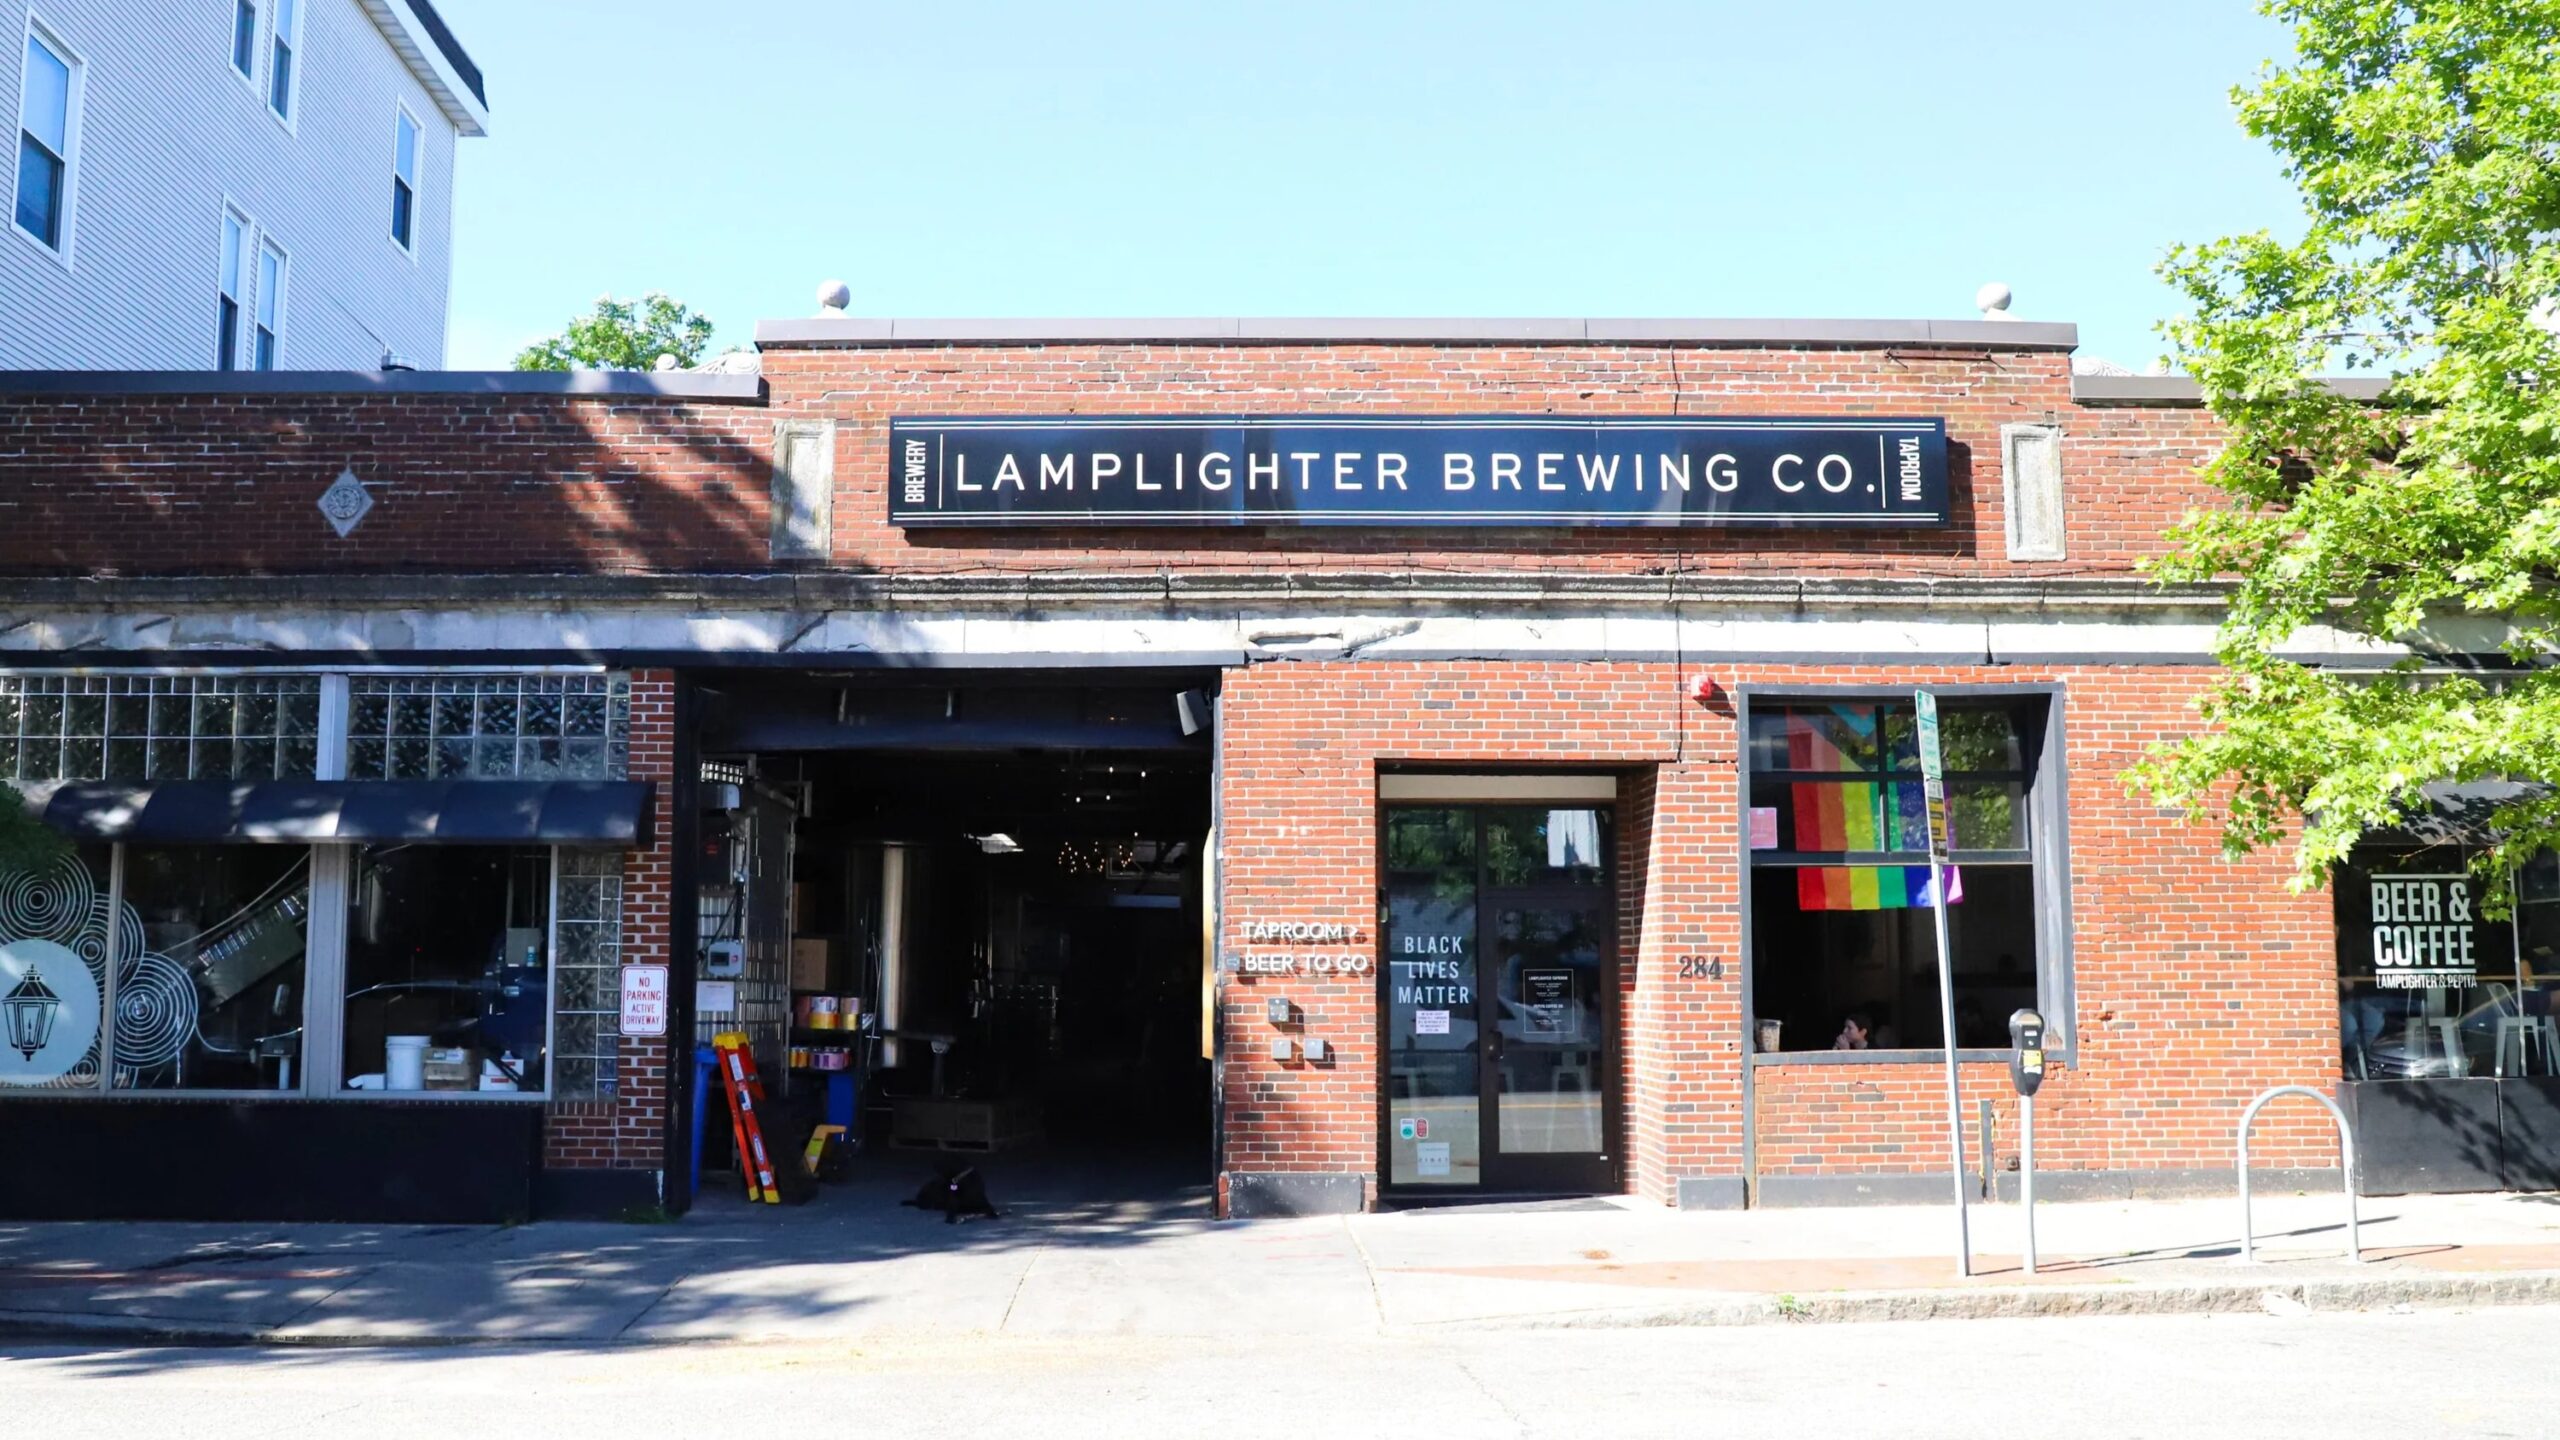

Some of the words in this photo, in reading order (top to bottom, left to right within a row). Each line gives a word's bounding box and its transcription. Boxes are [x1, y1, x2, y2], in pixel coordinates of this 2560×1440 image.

[905, 439, 926, 503] BREWERY
[956, 453, 1408, 491] LAMPLIGHTER
[1444, 453, 1739, 493] BREWING
[1771, 454, 1876, 493] CO.
[1899, 436, 1921, 501] TAPROOM
[2371, 882, 2441, 922] BEER
[2448, 882, 2473, 922] &
[1241, 921, 1342, 939] TAPROOM
[1404, 936, 1463, 954] BLACK
[2373, 925, 2476, 967] COFFEE
[1245, 953, 1294, 971] BEER
[1304, 953, 1330, 971] TO
[1337, 953, 1368, 972] GO
[1407, 961, 1460, 979] LIVES
[1679, 955, 1722, 980] 284
[639, 976, 650, 988] NO
[2376, 974, 2437, 989] LAMPLIGHTER
[2438, 974, 2447, 989] &
[2447, 974, 2478, 989] PEPITA
[626, 990, 662, 1001] PARKING
[1398, 986, 1470, 1004] MATTER
[632, 1003, 656, 1014] ACTIVE
[626, 1016, 660, 1025] DRIVEWAY
